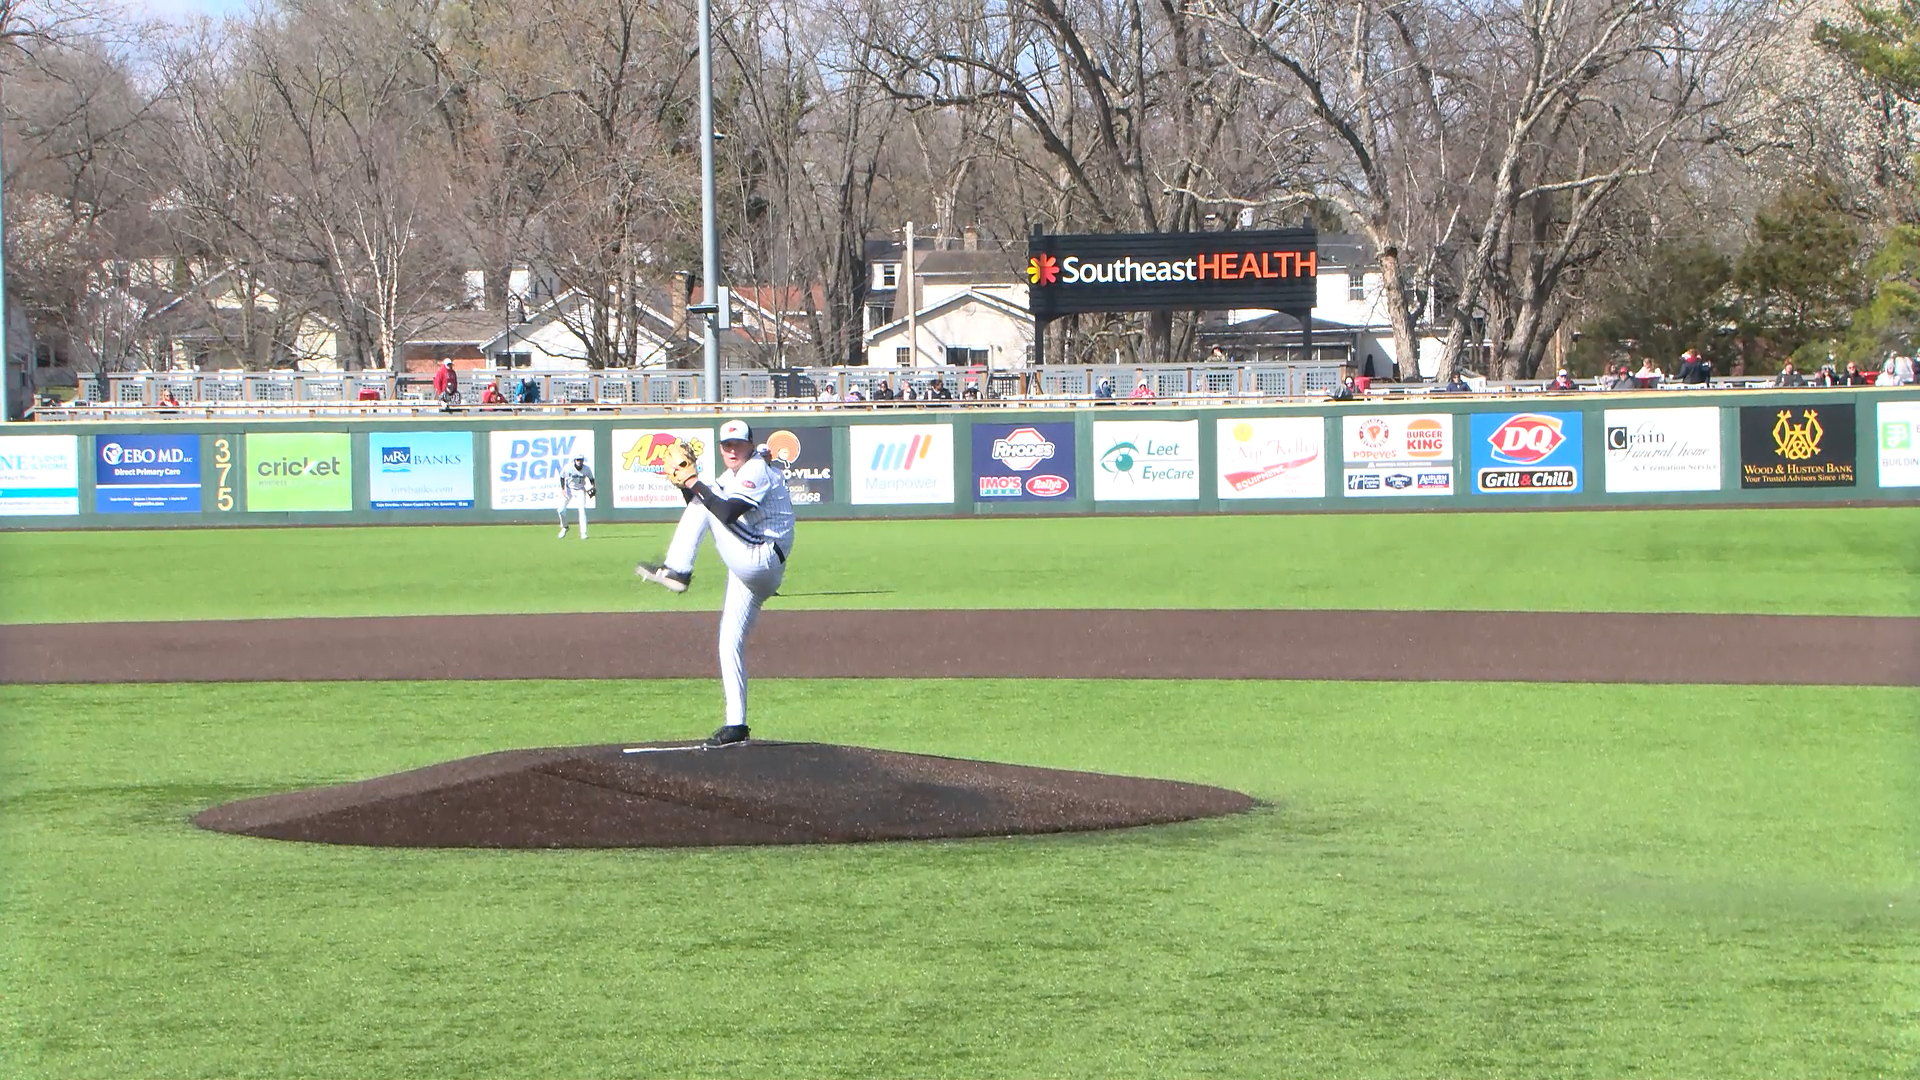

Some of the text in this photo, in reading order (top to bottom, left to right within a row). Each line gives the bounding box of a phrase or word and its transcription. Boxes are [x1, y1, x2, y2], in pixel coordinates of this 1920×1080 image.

[1407, 440, 1442, 450] KING
[1502, 426, 1550, 453] DQ
[1609, 428, 1665, 449] Crain
[510, 436, 576, 459] DSW
[994, 441, 1054, 458] RHODES
[1147, 440, 1180, 456] Leet
[1678, 441, 1709, 457] home
[124, 449, 156, 464] EBO
[158, 449, 184, 463] MD
[414, 454, 462, 465] BANKS
[114, 468, 181, 477] Direct Primary Care
[258, 456, 340, 476] cricket
[500, 456, 588, 482] SIGN
[1642, 464, 1686, 472] Cremation
[1775, 464, 1784, 474] &
[1142, 466, 1194, 482] EyeCare
[1485, 472, 1520, 488] Grill
[1520, 474, 1531, 486] &
[1787, 474, 1816, 482] Advisors
[865, 477, 937, 491] Manpower
[981, 477, 1021, 488] IMO'S
[1033, 479, 1062, 490] Rally's
